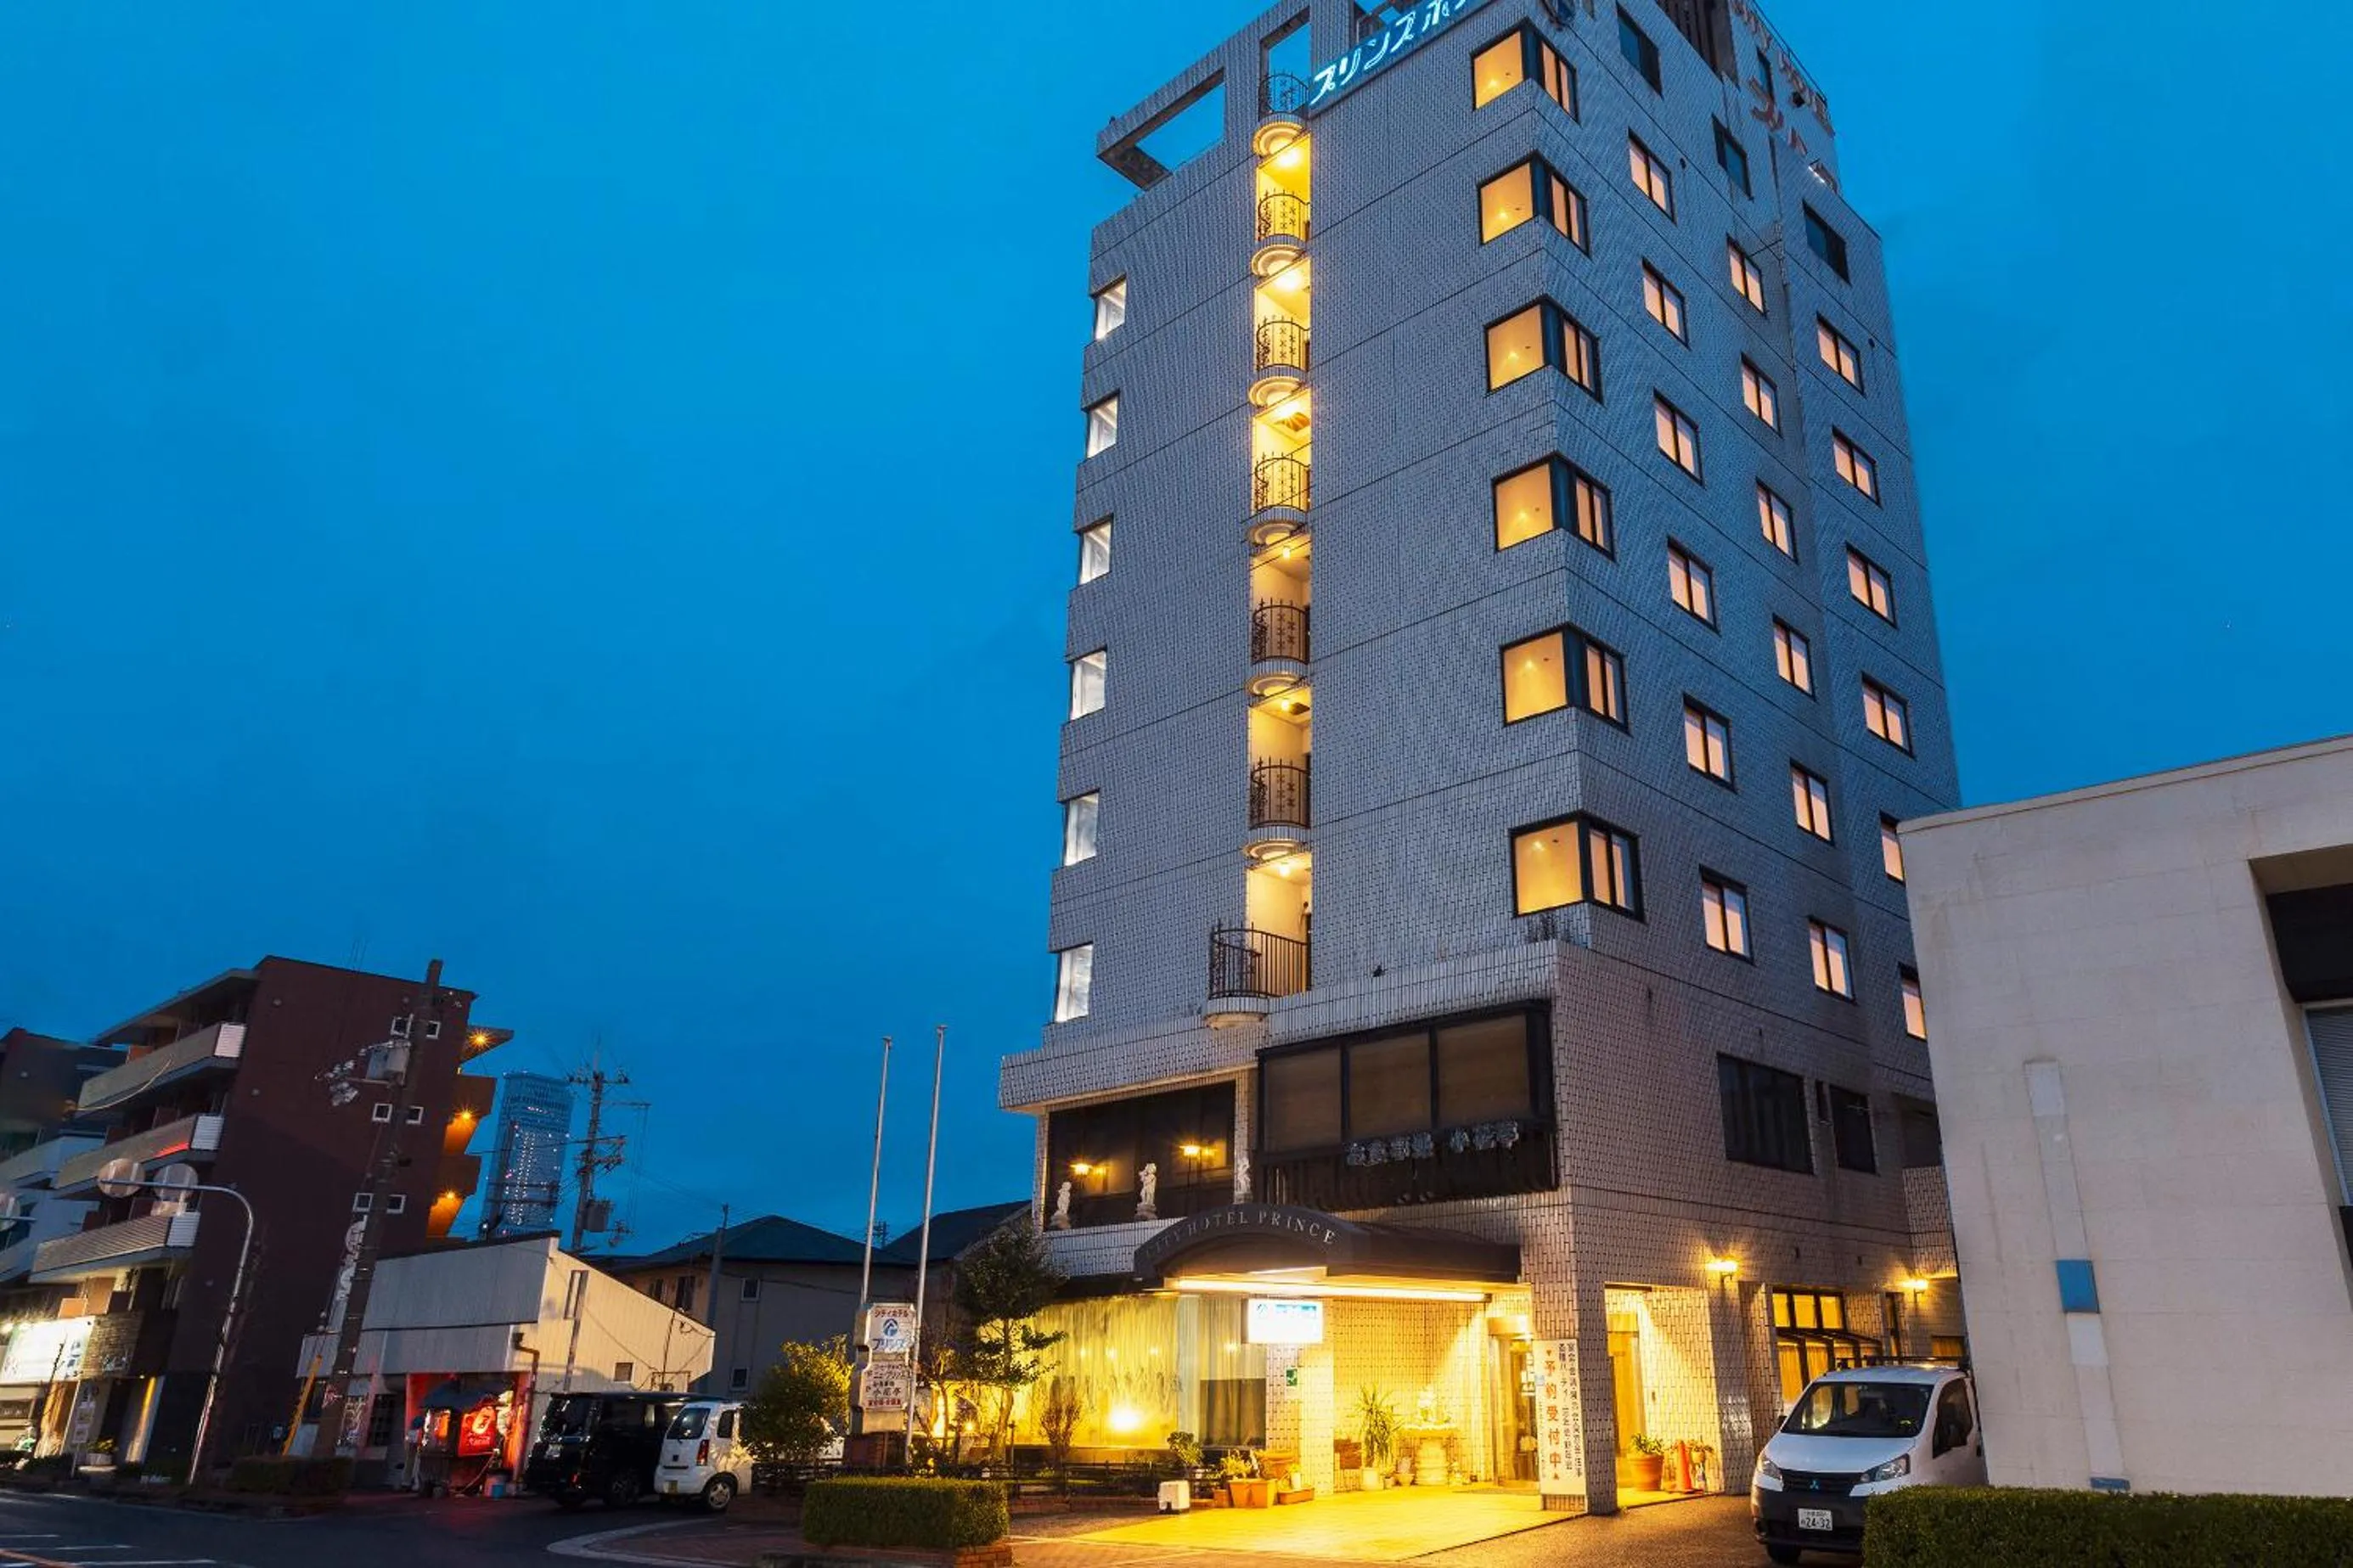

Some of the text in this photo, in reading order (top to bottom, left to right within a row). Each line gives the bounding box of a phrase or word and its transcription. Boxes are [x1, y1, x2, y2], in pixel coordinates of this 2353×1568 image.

[1187, 1211, 1249, 1236] HOTEL
[1258, 1211, 1337, 1245] PRINCE
[1544, 1360, 1562, 1468] 予約受付中
